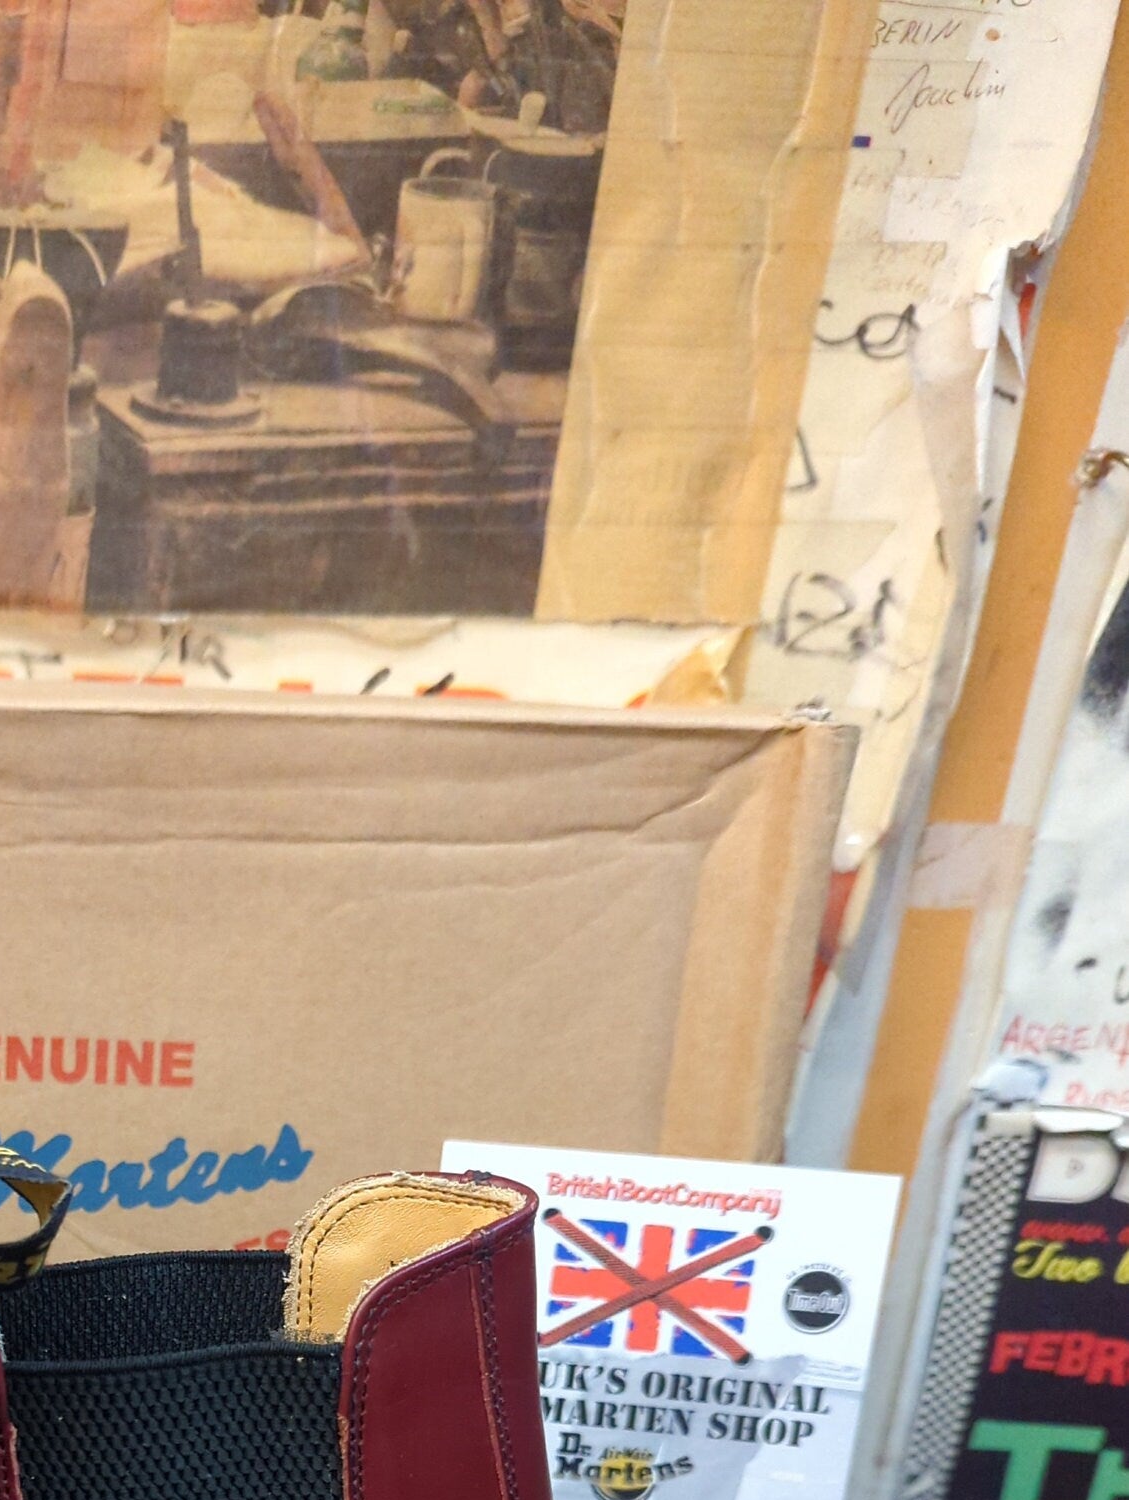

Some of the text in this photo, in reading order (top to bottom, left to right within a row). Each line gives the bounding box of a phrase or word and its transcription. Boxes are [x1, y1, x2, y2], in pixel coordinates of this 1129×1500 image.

[546, 1172, 782, 1221] BritishBootCompany
[1012, 1239, 1103, 1283] Two
[988, 1330, 1129, 1388] FEBR
[641, 1370, 831, 1416] ORIGINAL
[705, 1411, 816, 1449] SHOP
[553, 1454, 696, 1482] Martens
